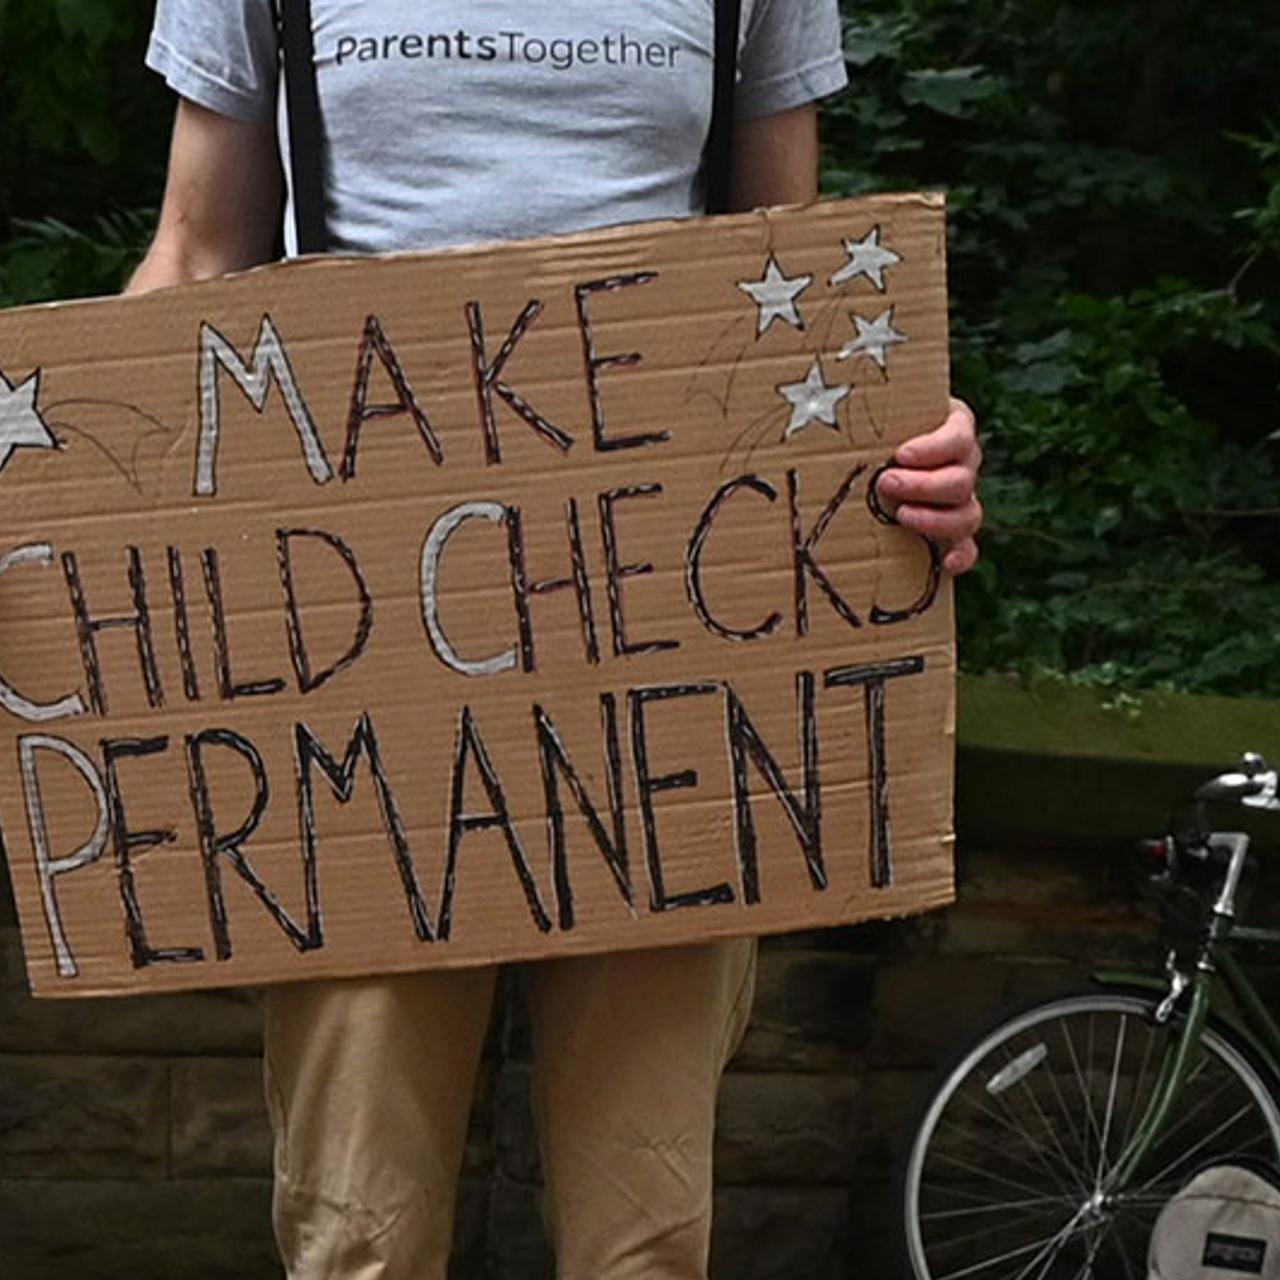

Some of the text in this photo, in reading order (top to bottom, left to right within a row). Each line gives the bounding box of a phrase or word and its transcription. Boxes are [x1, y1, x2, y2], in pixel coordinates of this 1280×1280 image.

[193, 271, 671, 497] MAKE
[418, 457, 942, 675] CHECKS
[18, 656, 925, 978] PERMANENT
